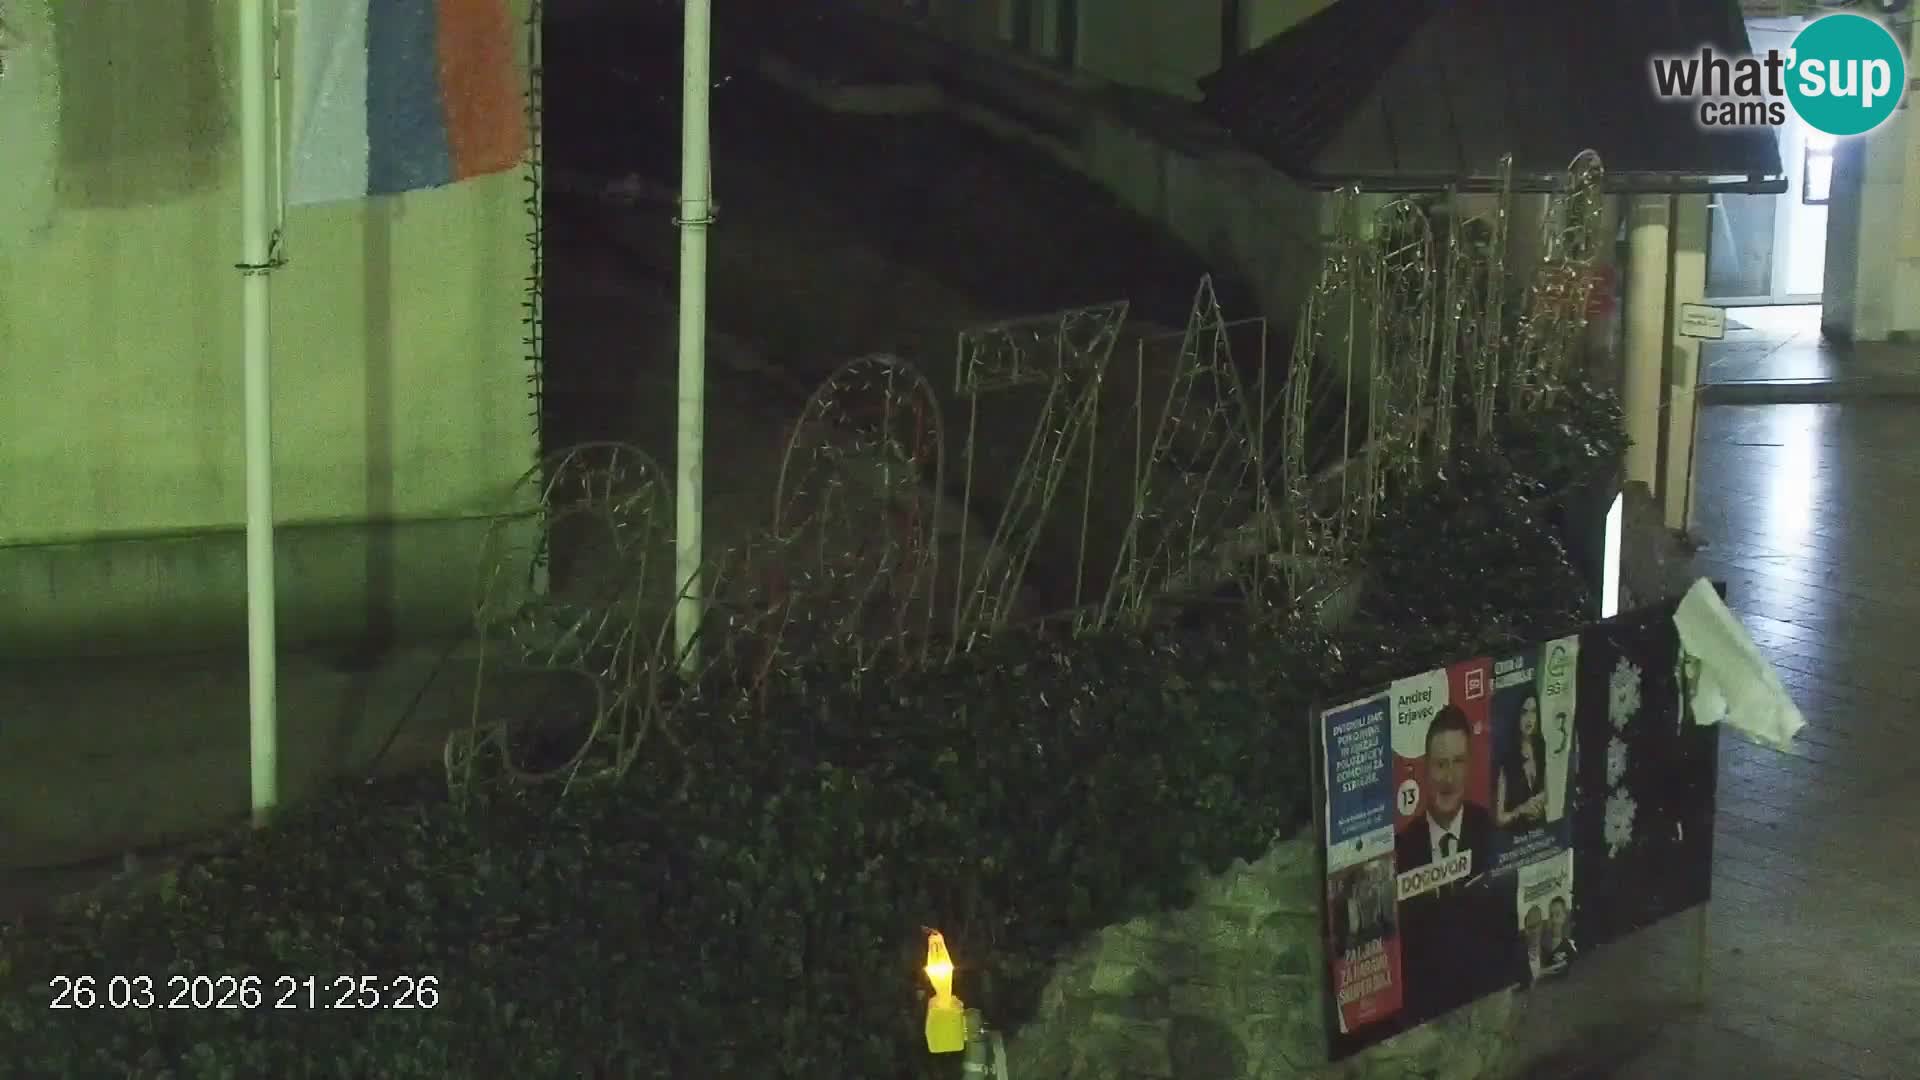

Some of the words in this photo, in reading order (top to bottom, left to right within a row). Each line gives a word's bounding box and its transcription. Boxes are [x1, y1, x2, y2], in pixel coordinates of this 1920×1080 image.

[1398, 686, 1432, 706] Andrej
[1398, 706, 1434, 726] Erjavec
[1554, 710, 1568, 755] 3
[1402, 788, 1416, 807] 13
